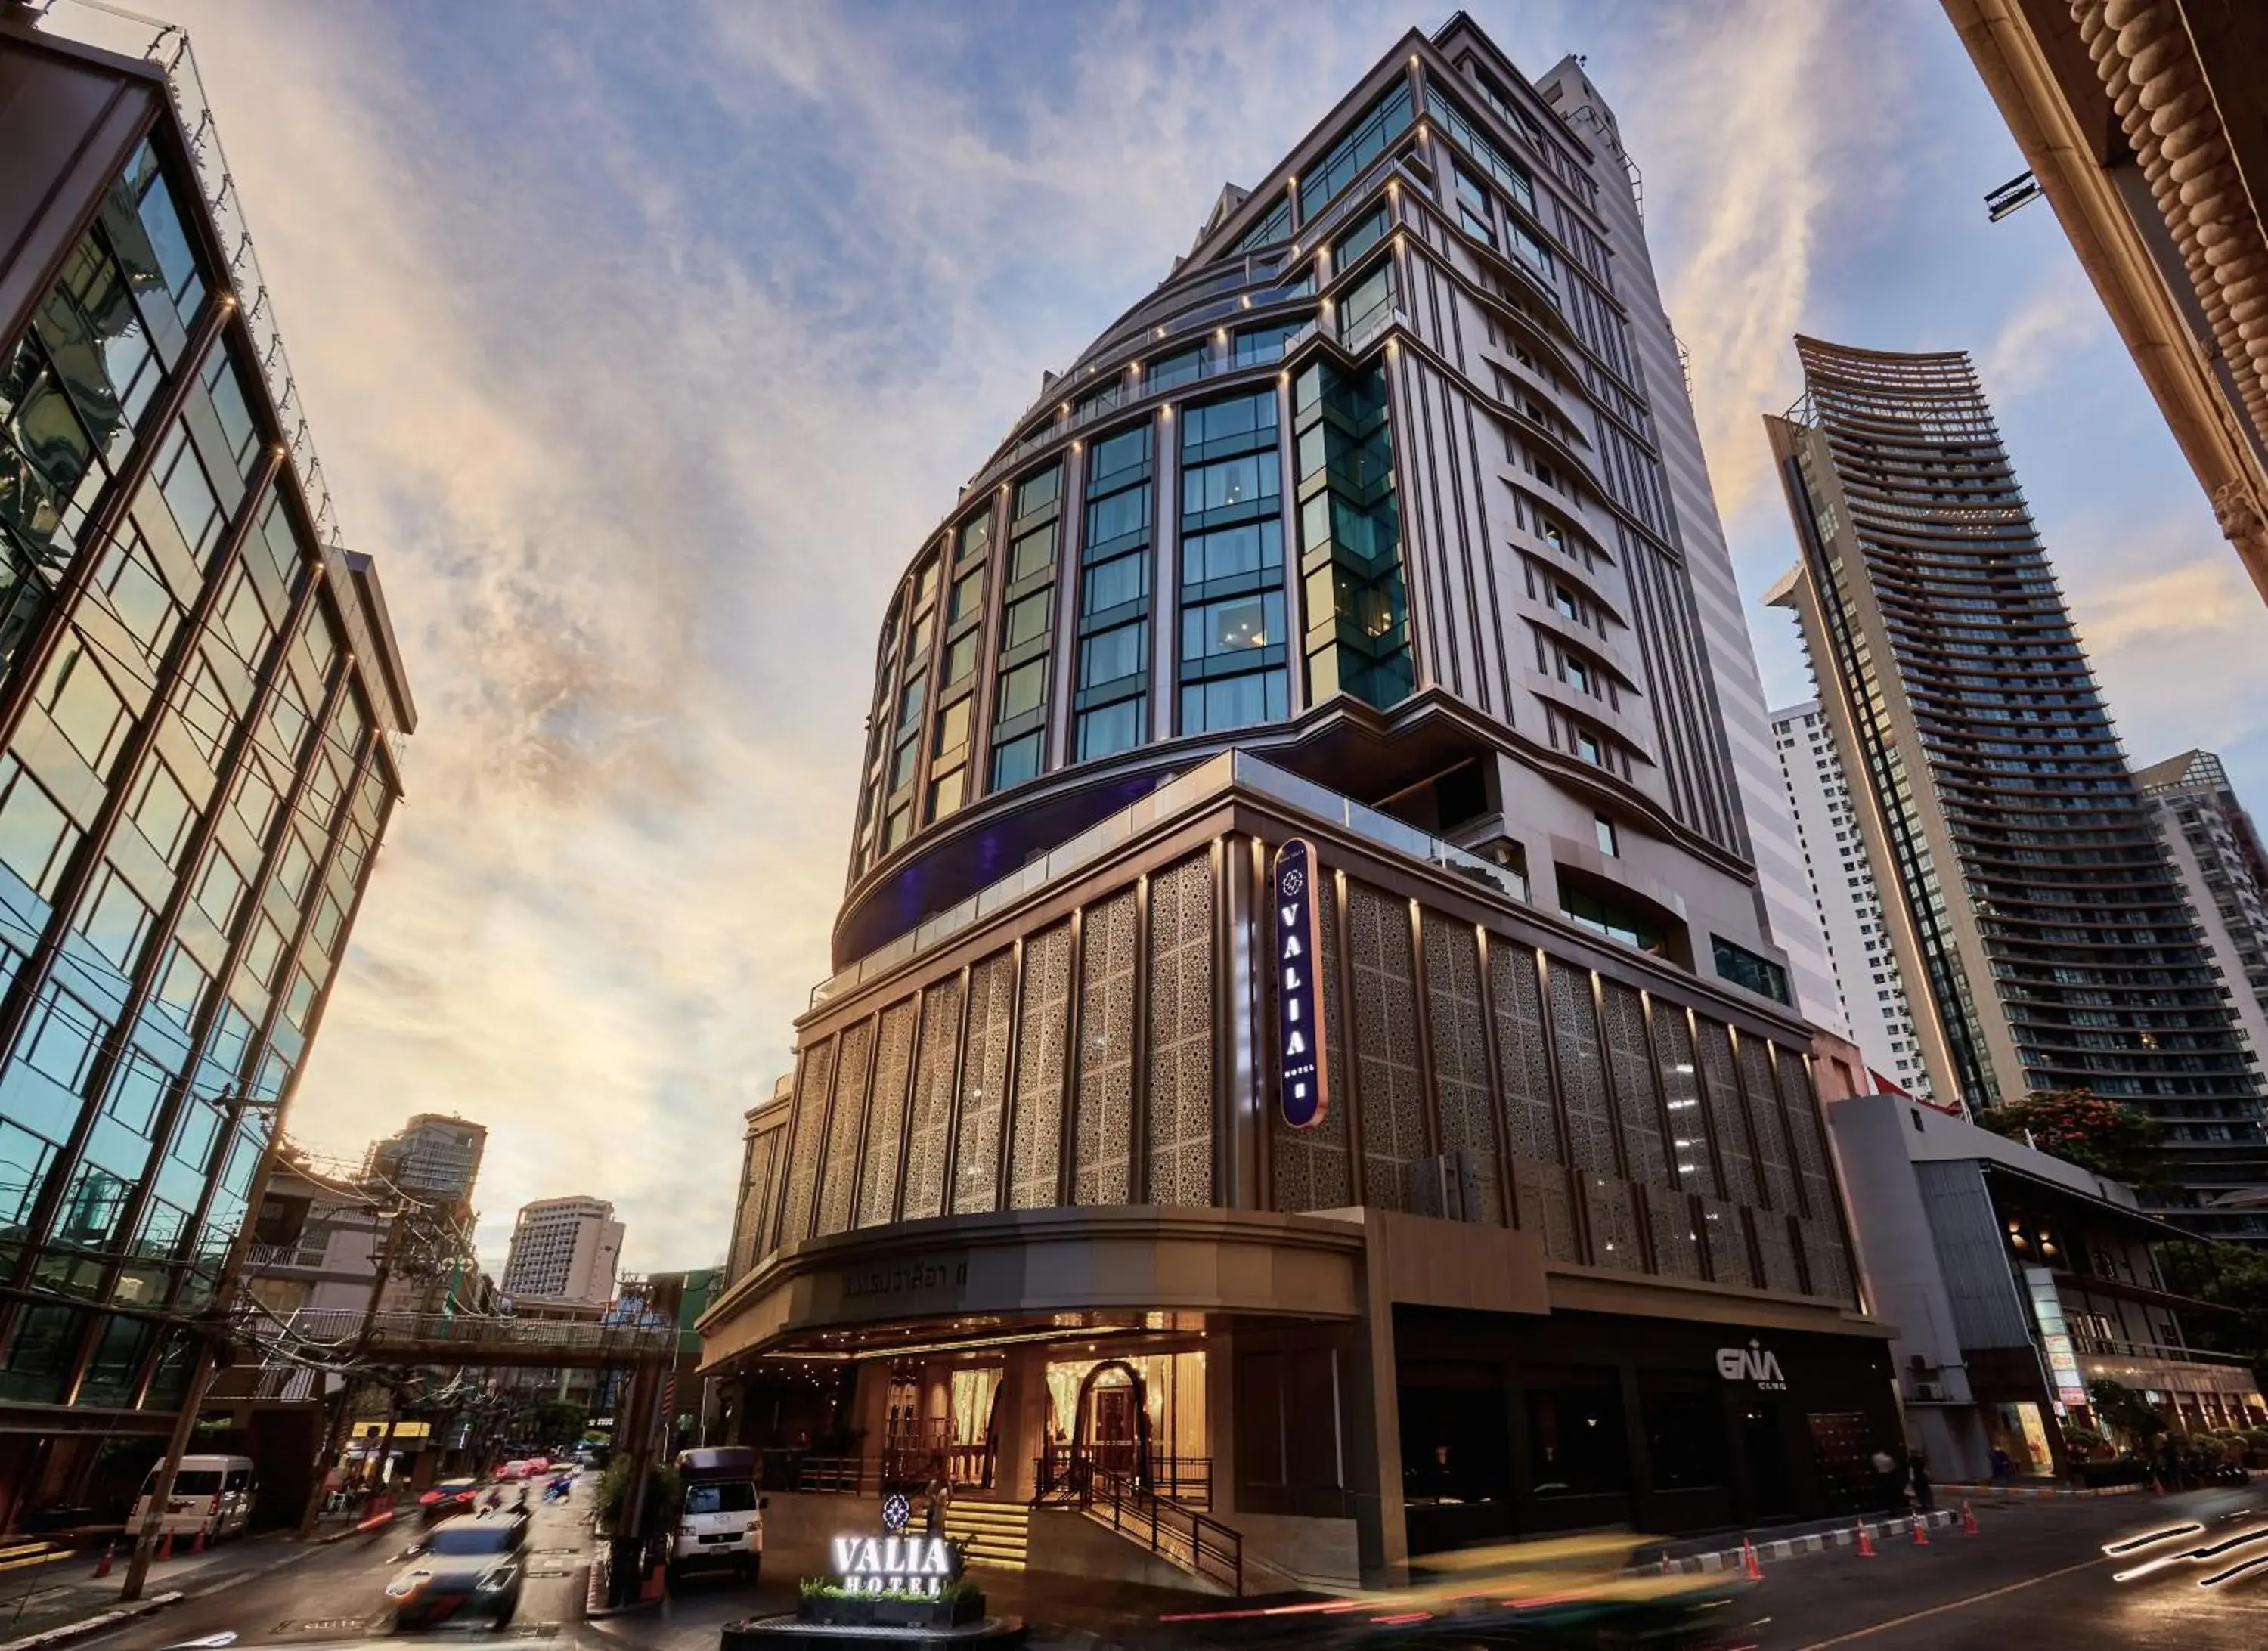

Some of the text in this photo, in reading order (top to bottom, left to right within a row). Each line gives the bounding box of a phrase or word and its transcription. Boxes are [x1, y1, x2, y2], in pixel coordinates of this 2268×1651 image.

[1281, 903, 1306, 1055] VALIA
[1284, 1064, 1314, 1079] HOTEL
[1716, 1338, 1784, 1380] GAIA
[834, 1537, 949, 1572] VALIA
[845, 1576, 941, 1596] HOTEL
